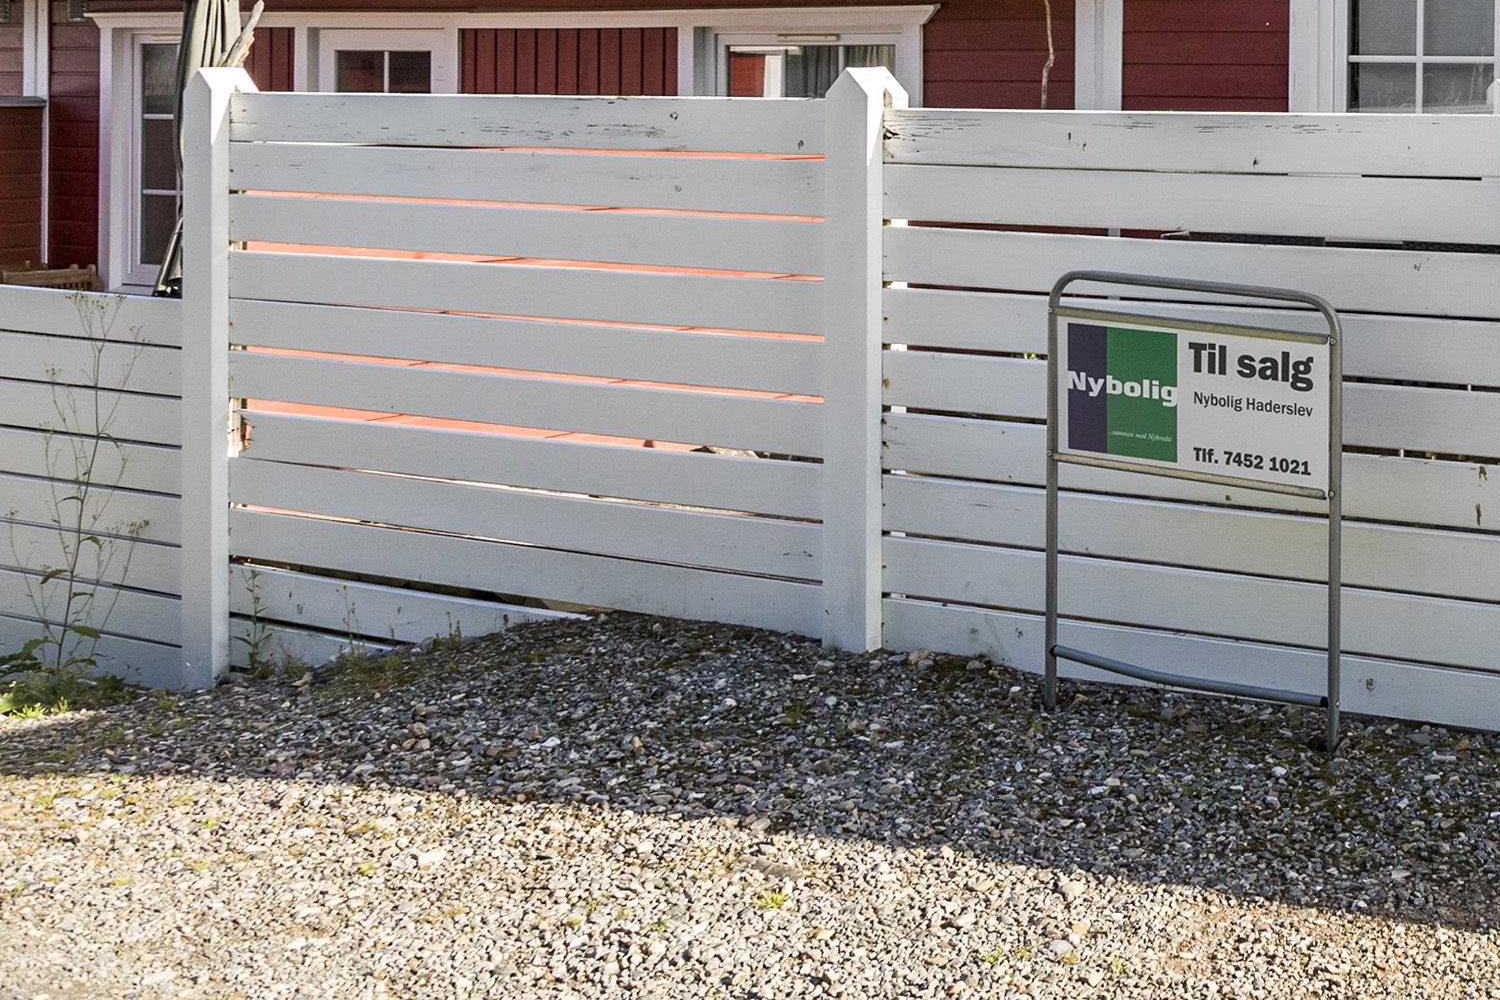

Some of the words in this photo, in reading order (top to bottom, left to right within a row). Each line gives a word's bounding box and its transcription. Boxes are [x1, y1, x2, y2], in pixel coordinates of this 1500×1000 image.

[1188, 341, 1227, 376] Til
[1236, 351, 1314, 392] salg
[1067, 370, 1178, 408] Nybolig
[1193, 391, 1242, 412] Nybolig
[1246, 397, 1313, 417] Haderslev
[1193, 447, 1219, 465] Tlf.
[1223, 450, 1264, 470] 7452
[1269, 456, 1311, 476] 1021
